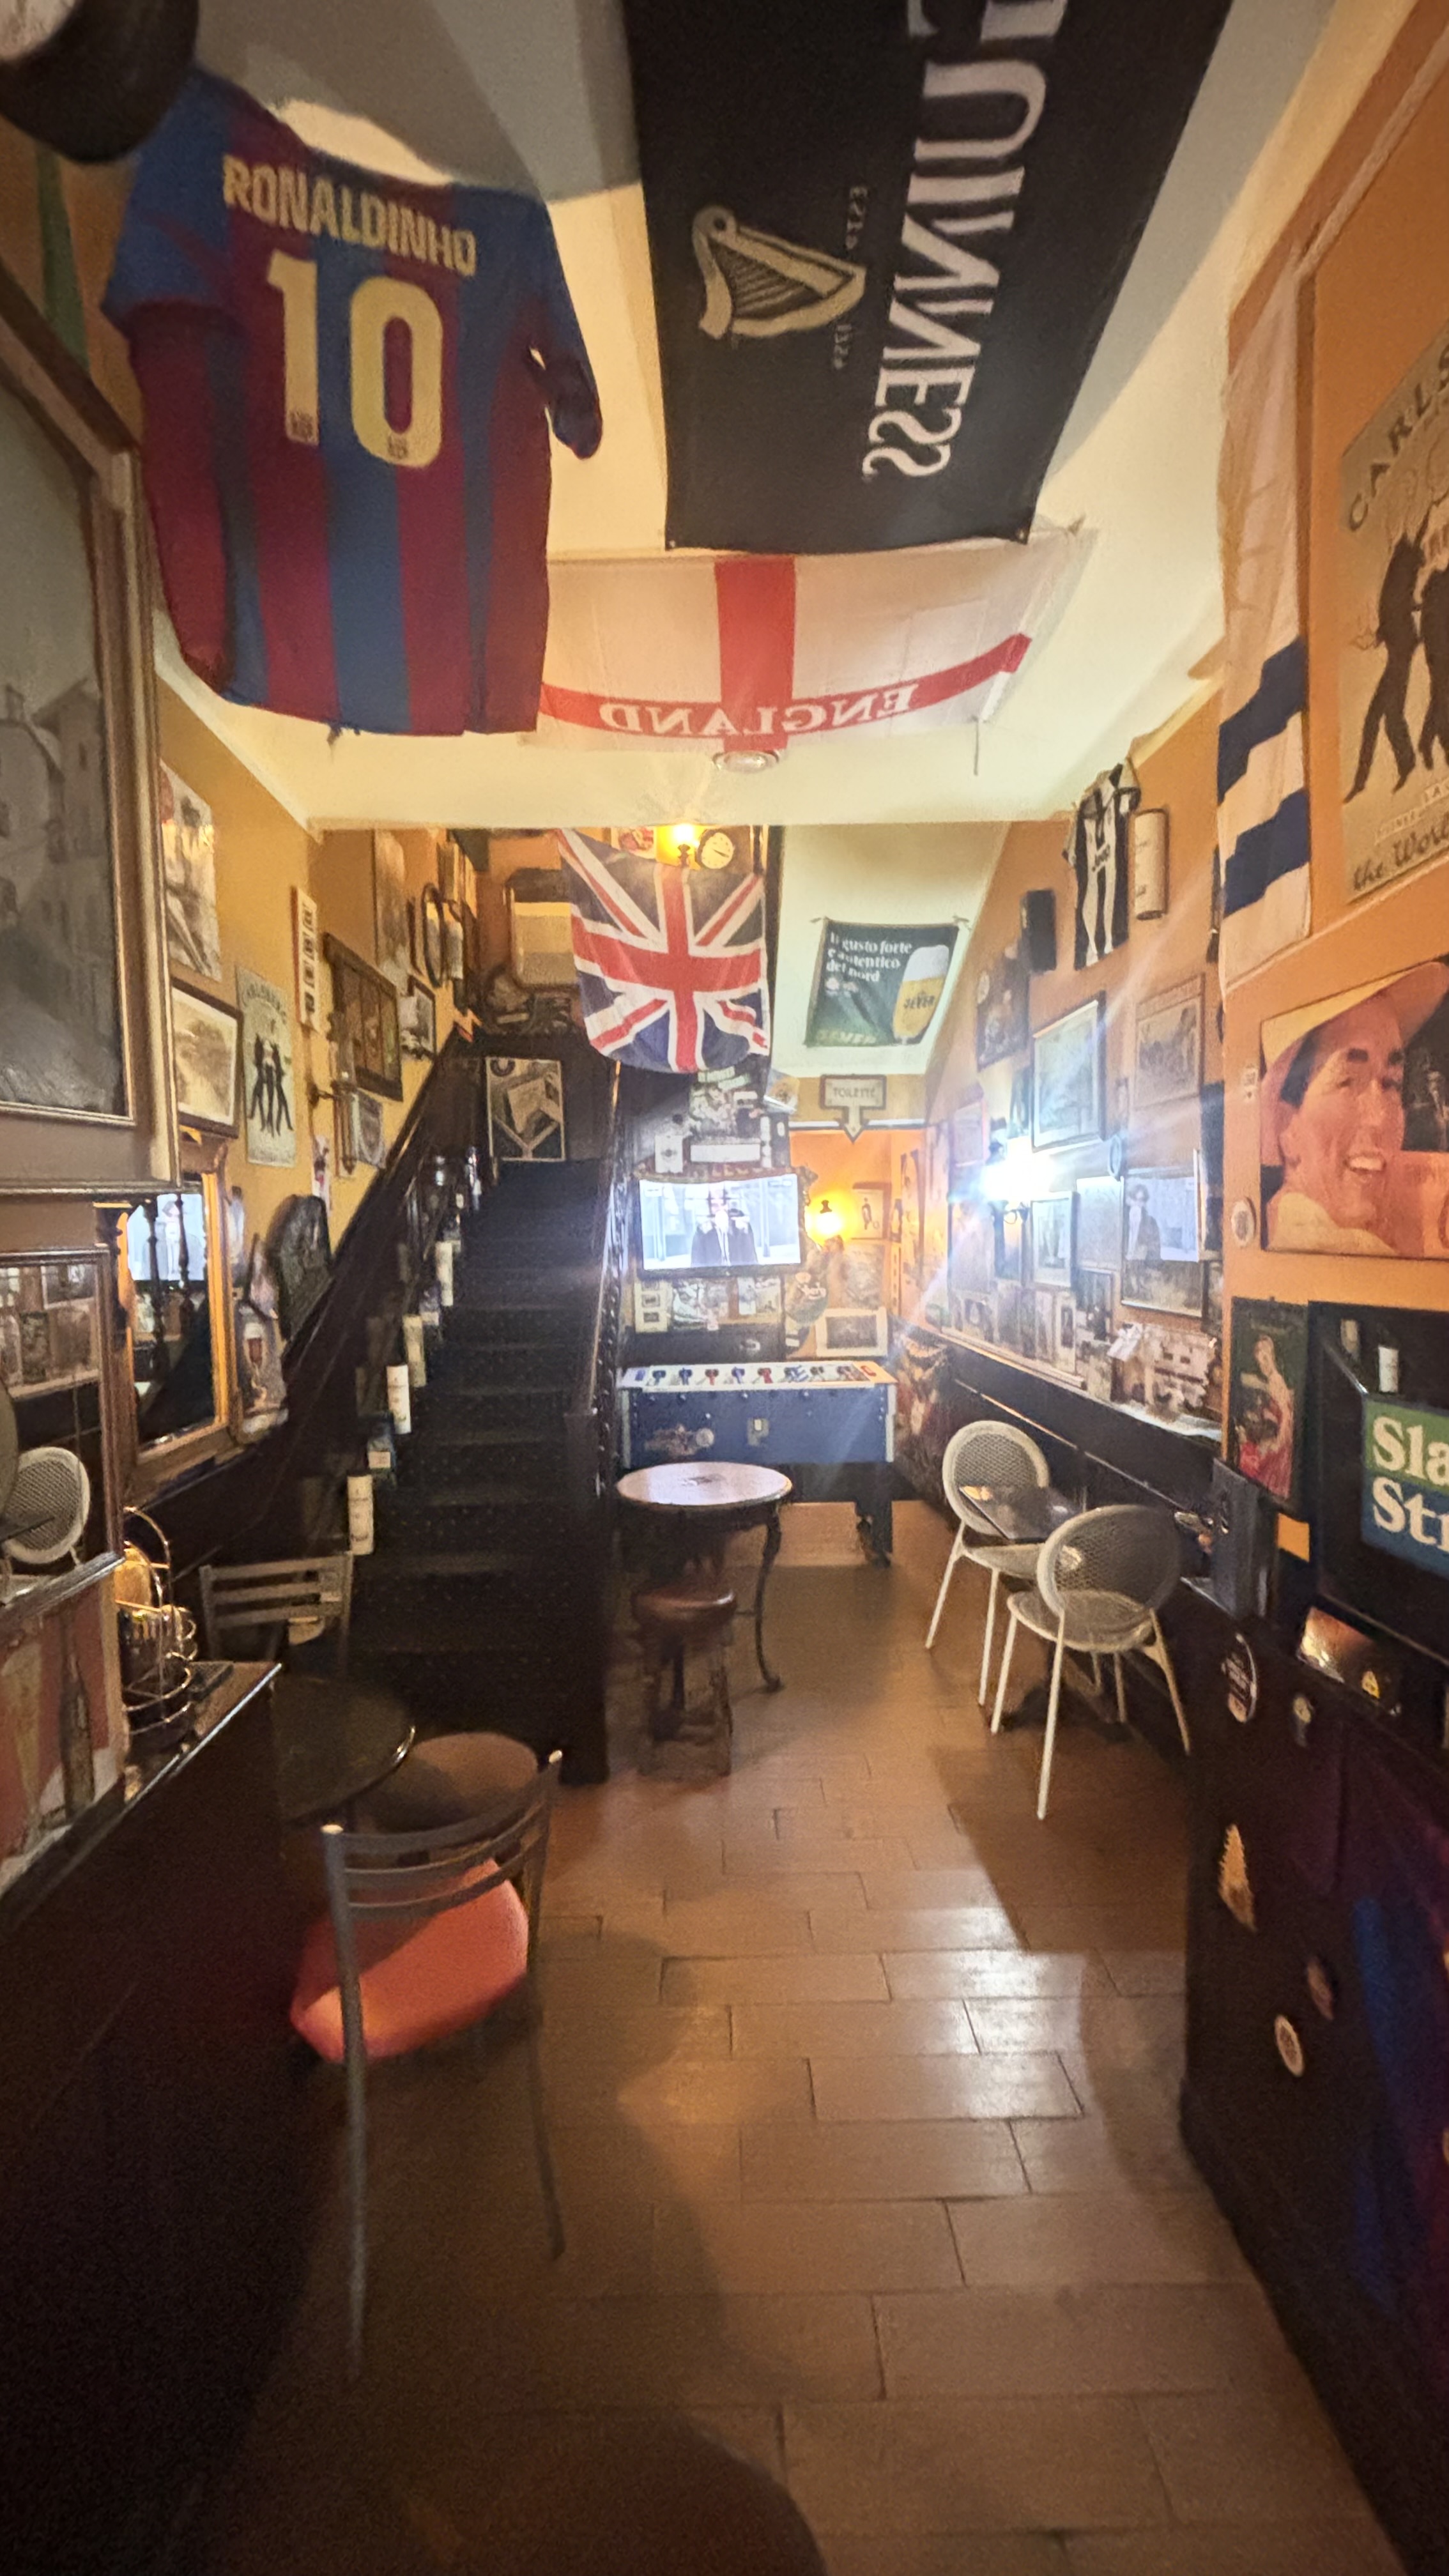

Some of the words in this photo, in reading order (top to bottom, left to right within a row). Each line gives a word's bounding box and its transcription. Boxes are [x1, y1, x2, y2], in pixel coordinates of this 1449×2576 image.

[222, 154, 477, 277] RONALDINHO
[266, 249, 443, 469] 10
[841, 939, 879, 953] gusto
[880, 939, 913, 955] forte
[1372, 1415, 1449, 1486] Sla
